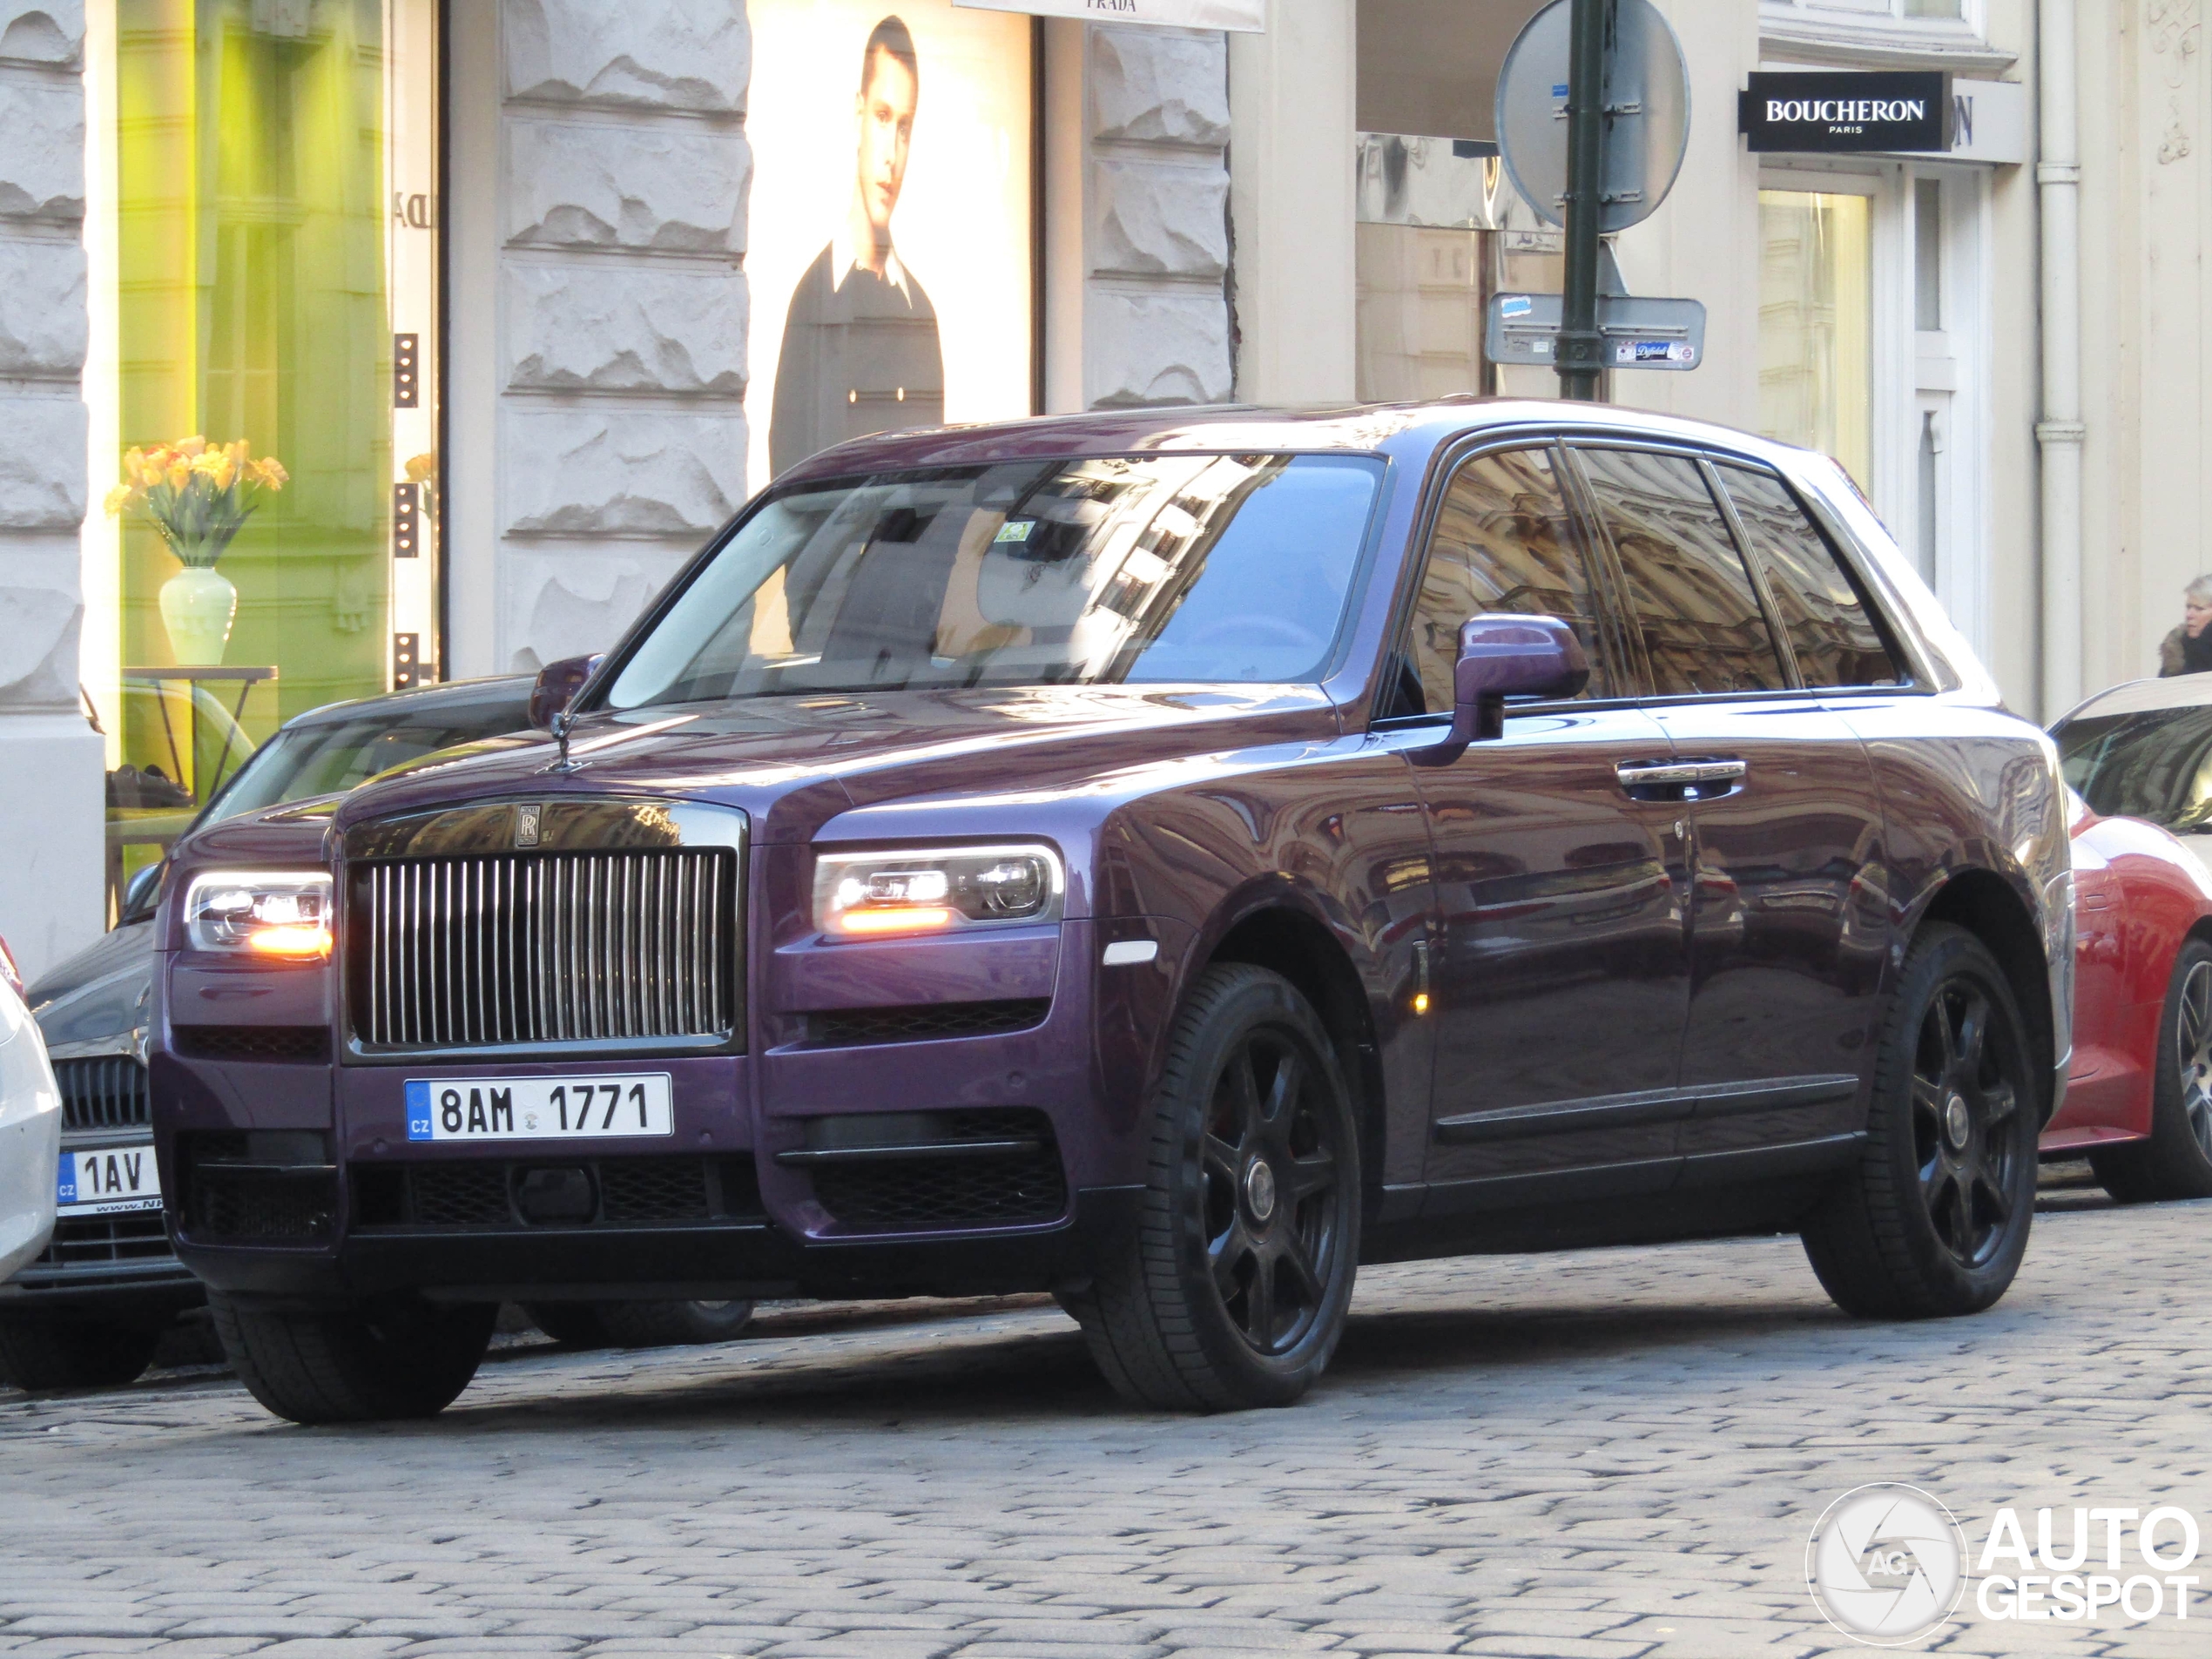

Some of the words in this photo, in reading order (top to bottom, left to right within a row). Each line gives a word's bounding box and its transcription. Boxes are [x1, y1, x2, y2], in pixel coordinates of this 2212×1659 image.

[1765, 99, 1925, 122] BOUCHERON
[1952, 95, 1974, 146] N
[1829, 125, 1863, 134] PARIS
[441, 1086, 514, 1132] 8AM
[550, 1082, 648, 1130] 1771
[411, 1119, 429, 1133] CZ
[84, 1152, 141, 1194] 1AV
[59, 1184, 75, 1197] CZ
